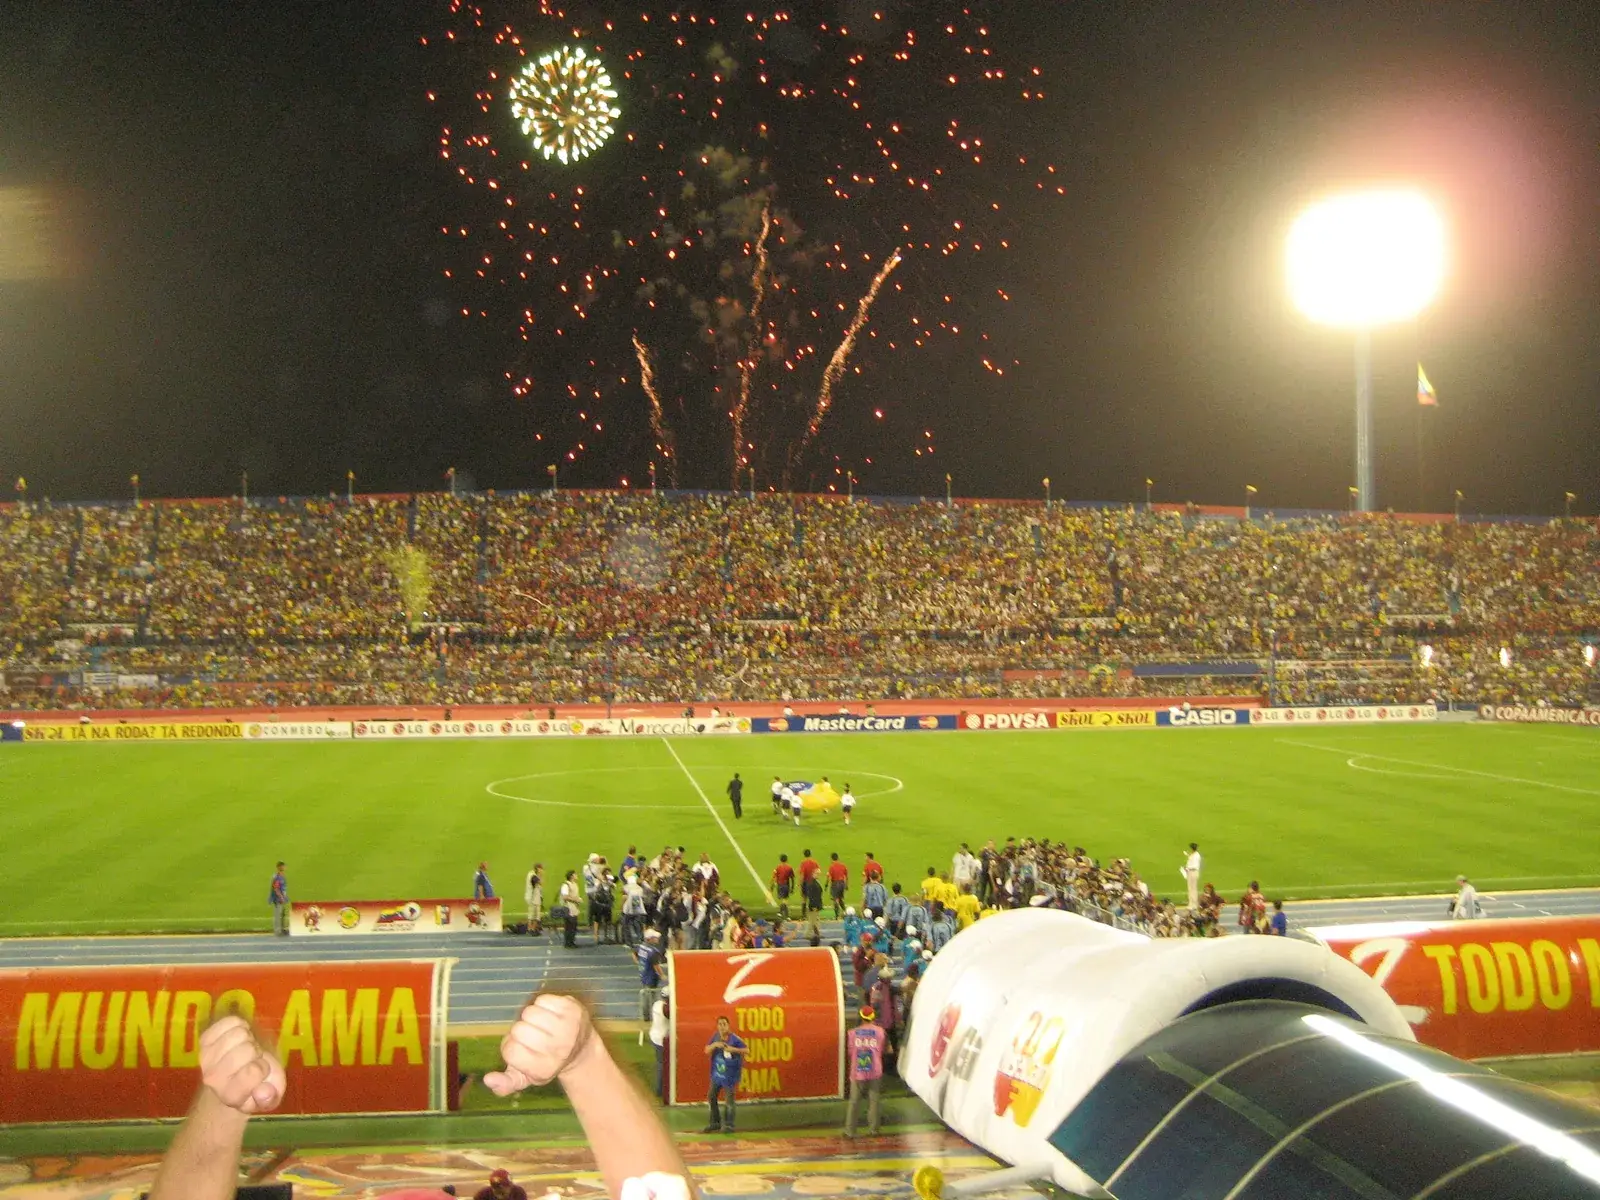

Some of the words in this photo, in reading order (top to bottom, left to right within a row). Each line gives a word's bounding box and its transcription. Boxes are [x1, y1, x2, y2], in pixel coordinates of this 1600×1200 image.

[804, 716, 906, 731] MasterCard
[983, 712, 1051, 729] PDVSA
[1169, 708, 1237, 726] CASIO
[1264, 711, 1279, 721] LG
[1296, 710, 1312, 720] LG
[1328, 709, 1344, 719] LG
[1357, 709, 1372, 719] LG
[1389, 708, 1404, 718] LG
[370, 724, 386, 734] LG
[407, 724, 424, 734] LG
[444, 723, 460, 733] LG
[478, 723, 494, 733] LG
[515, 723, 532, 733] LG
[552, 722, 569, 732] LG
[1422, 939, 1572, 1015] TODO
[278, 987, 424, 1067] AMA
[735, 1006, 785, 1032] TODO
[744, 1036, 793, 1063] UNDO
[738, 1066, 782, 1093] AMA
